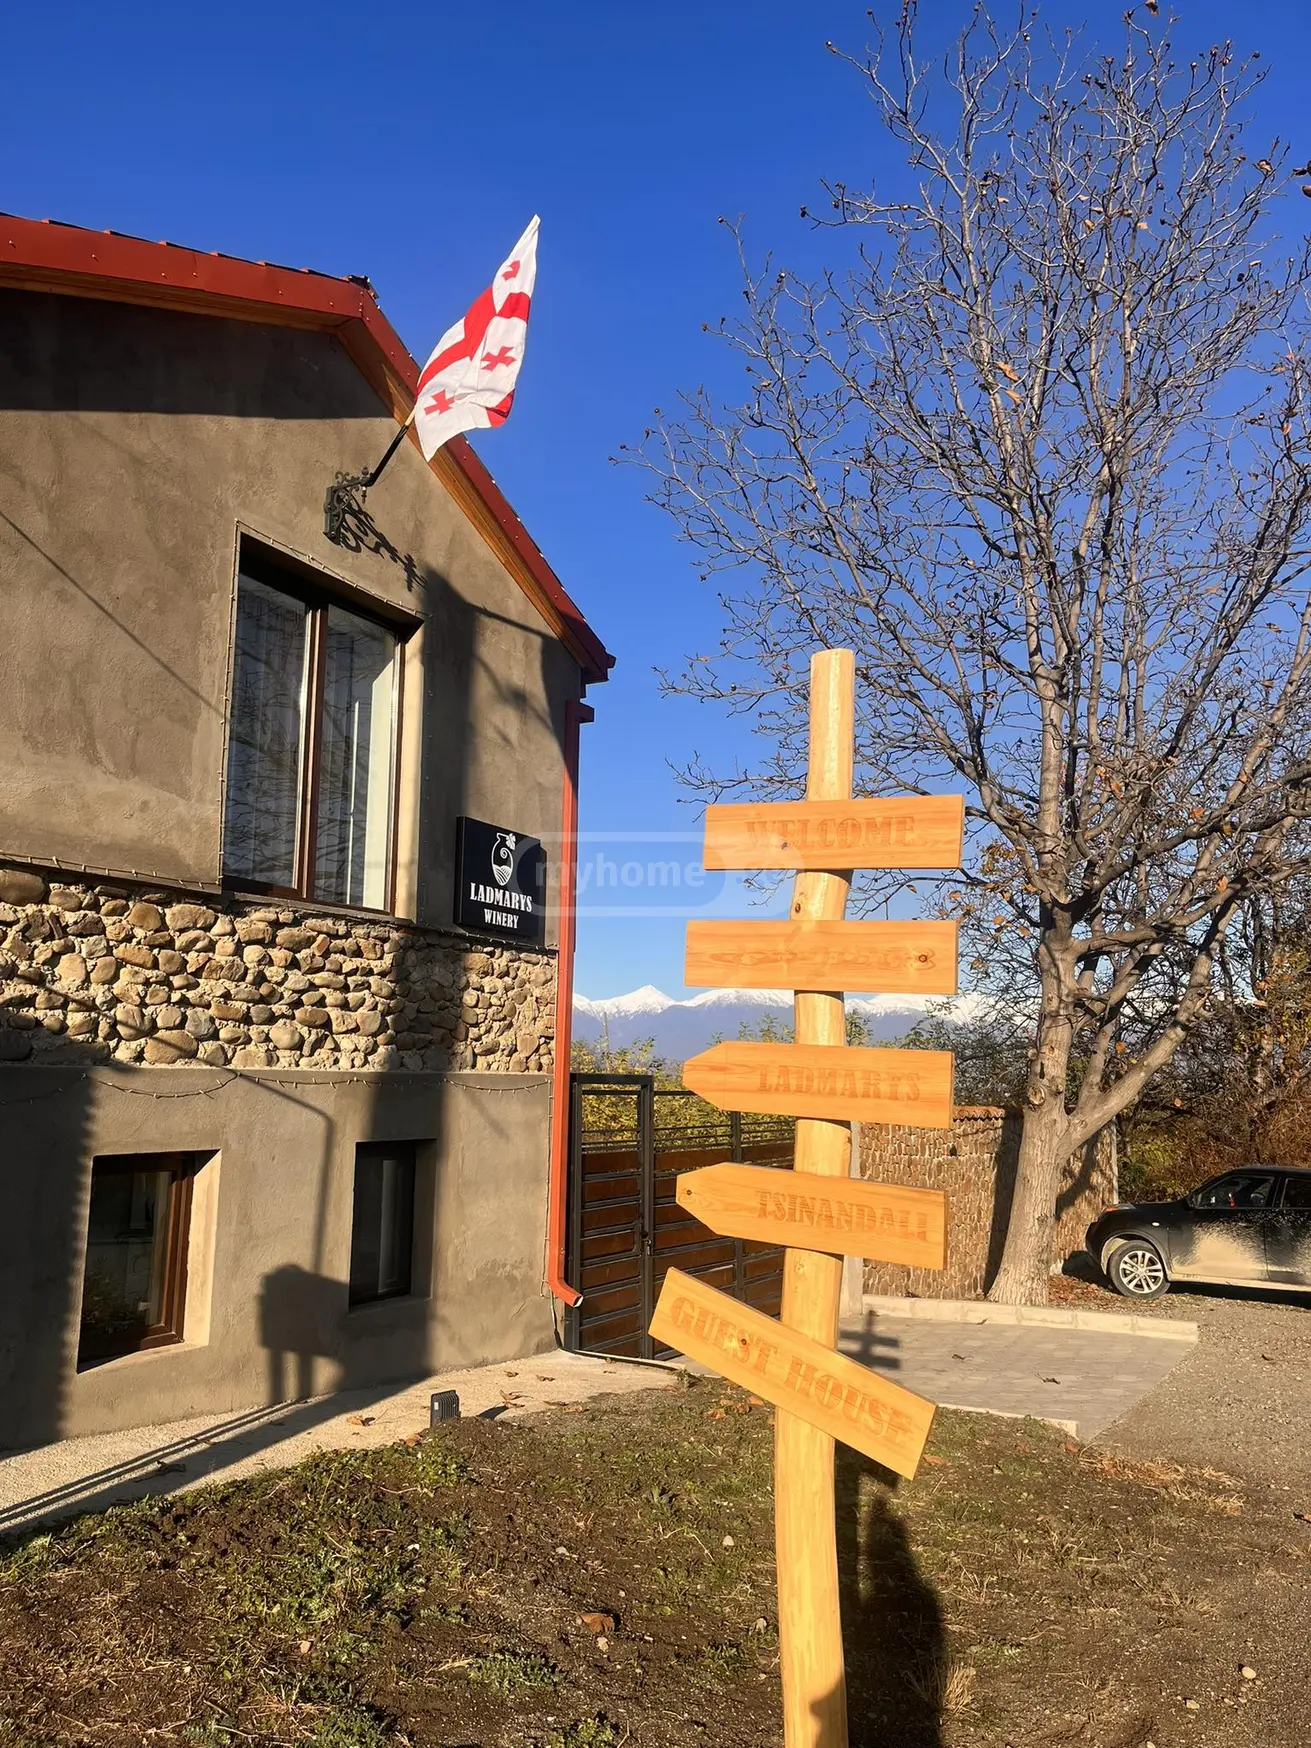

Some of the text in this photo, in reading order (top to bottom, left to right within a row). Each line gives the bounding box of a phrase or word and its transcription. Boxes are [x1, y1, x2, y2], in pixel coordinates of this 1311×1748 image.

[745, 816, 914, 848] WELCOME
[470, 882, 532, 912] LADMARYS
[484, 908, 519, 929] WINERY
[758, 1064, 921, 1101] LADMARYS
[756, 1190, 927, 1241] TSINANDALI
[671, 1297, 913, 1445] GUEST HOUSE
